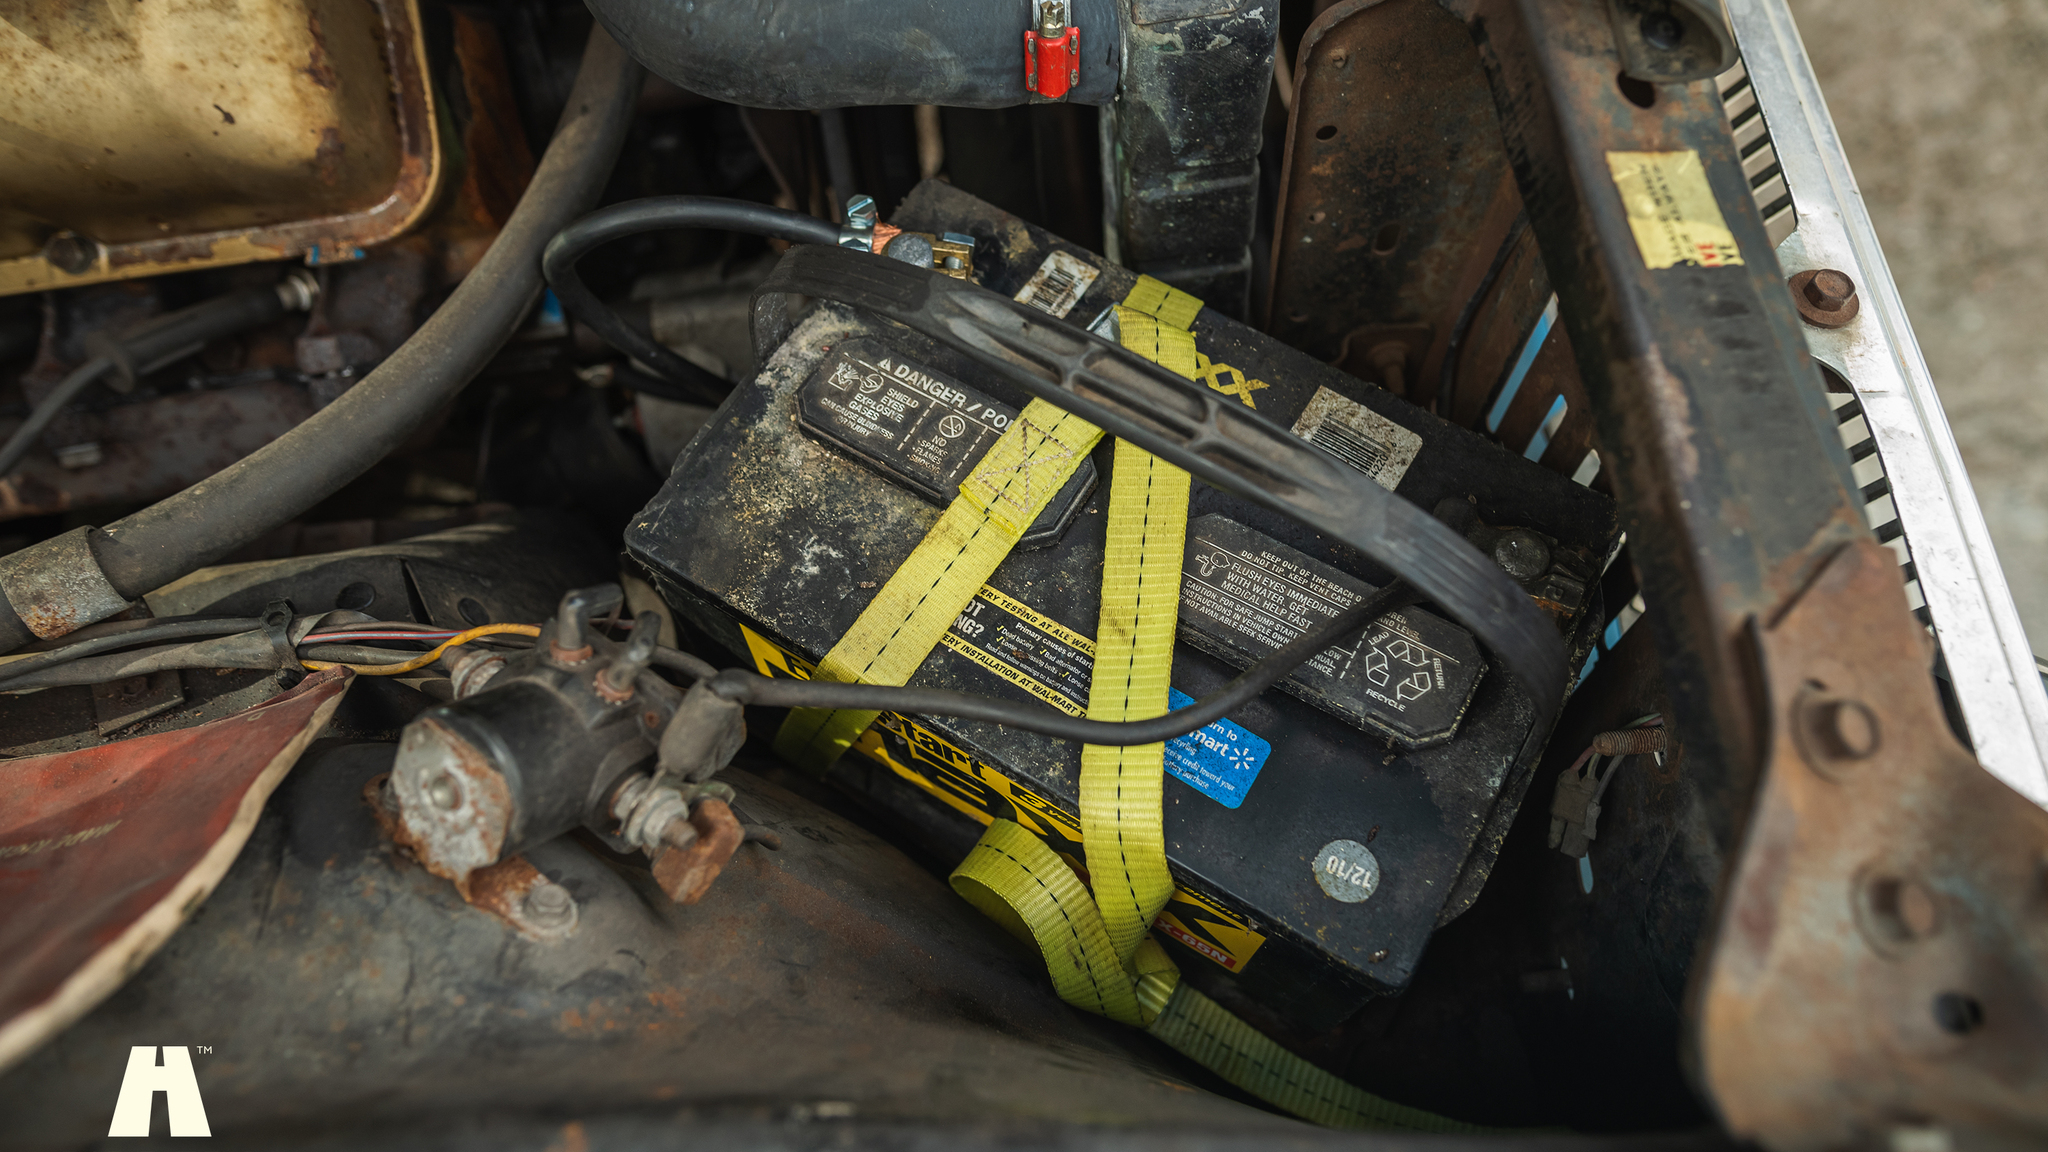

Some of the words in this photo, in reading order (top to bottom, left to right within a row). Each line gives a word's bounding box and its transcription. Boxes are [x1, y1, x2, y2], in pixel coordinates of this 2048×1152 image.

[880, 395, 905, 412] EYES
[887, 388, 919, 408] SHIELD
[894, 364, 967, 408] DANGER
[965, 403, 982, 412] /
[822, 398, 836, 409] CAN
[835, 404, 858, 421] CAUSE
[856, 416, 895, 440] BLINDNESS
[848, 401, 880, 421] GASES
[854, 393, 904, 423] EXPLOSIVE
[846, 420, 872, 437] INJURY
[932, 435, 947, 447] NO
[909, 454, 941, 473] SMOKING
[915, 447, 943, 465] FLAMES
[920, 439, 949, 457] SPARKS
[1231, 562, 1262, 582] FLUSH
[1262, 577, 1286, 594] EYES
[1241, 550, 1253, 560] DO
[1254, 556, 1272, 568] NOT
[1271, 564, 1285, 576] TIP.
[1288, 572, 1308, 585] KEEP
[1310, 582, 1329, 596] VENT
[1331, 592, 1352, 607] CAPS
[1261, 551, 1281, 564] KEEP
[1282, 560, 1299, 572] OUT
[1300, 569, 1311, 577] OF
[1312, 574, 1328, 586] THE
[1328, 582, 1355, 599] REACH
[1185, 580, 1219, 600] CAUTION:
[1218, 597, 1235, 609] FOR
[1235, 604, 1254, 618] SAFE
[1253, 615, 1275, 629] JUMP
[1274, 624, 1300, 639] START
[1221, 580, 1260, 606] MEDICAL
[1262, 600, 1287, 616] HELP
[1288, 612, 1314, 629] FAST
[1227, 571, 1251, 589] WITH
[1253, 584, 1286, 607] WATER.
[1289, 602, 1309, 615] GET
[980, 587, 1000, 601] ERY
[1000, 600, 1038, 623] TESTING
[1039, 621, 1052, 630] AT
[1052, 629, 1069, 641] ALL
[1071, 638, 1095, 656] WAL-
[1181, 587, 1233, 617] INSTRUCTIONS
[1233, 612, 1242, 621] IN
[1242, 617, 1273, 636] VEHICLE
[1272, 632, 1292, 644] OWN
[1184, 598, 1201, 610] NOT
[1199, 606, 1238, 628] AVAILABLE
[1237, 624, 1257, 638] SEEK
[1001, 628, 1017, 640] Dead
[1016, 635, 1035, 650] battery
[1044, 651, 1057, 662] Bad
[1055, 659, 1081, 676] alternator
[1080, 672, 1088, 680] or
[1016, 622, 1042, 642] Primary
[1042, 638, 1067, 655] causes
[1368, 631, 1390, 646] LEAD
[942, 632, 961, 647] ERY
[960, 645, 1020, 680] INSTALLATION
[1018, 678, 1033, 687] AT
[1031, 684, 1078, 713] WAL-MART
[985, 642, 998, 653] Read
[997, 650, 1007, 659] and
[1061, 685, 1072, 694] and
[1001, 638, 1018, 650] Loose
[1067, 675, 1084, 690] Loose
[1432, 657, 1445, 690] RETURN
[1365, 688, 1407, 712] RECYCLE
[1226, 730, 1238, 741] to
[1182, 758, 1200, 771] credit
[1199, 767, 1222, 783] toward
[1219, 780, 1235, 791] your
[1182, 771, 1209, 789] purchase
[1020, 793, 1047, 809] 3
[1325, 855, 1371, 888] 12/10
